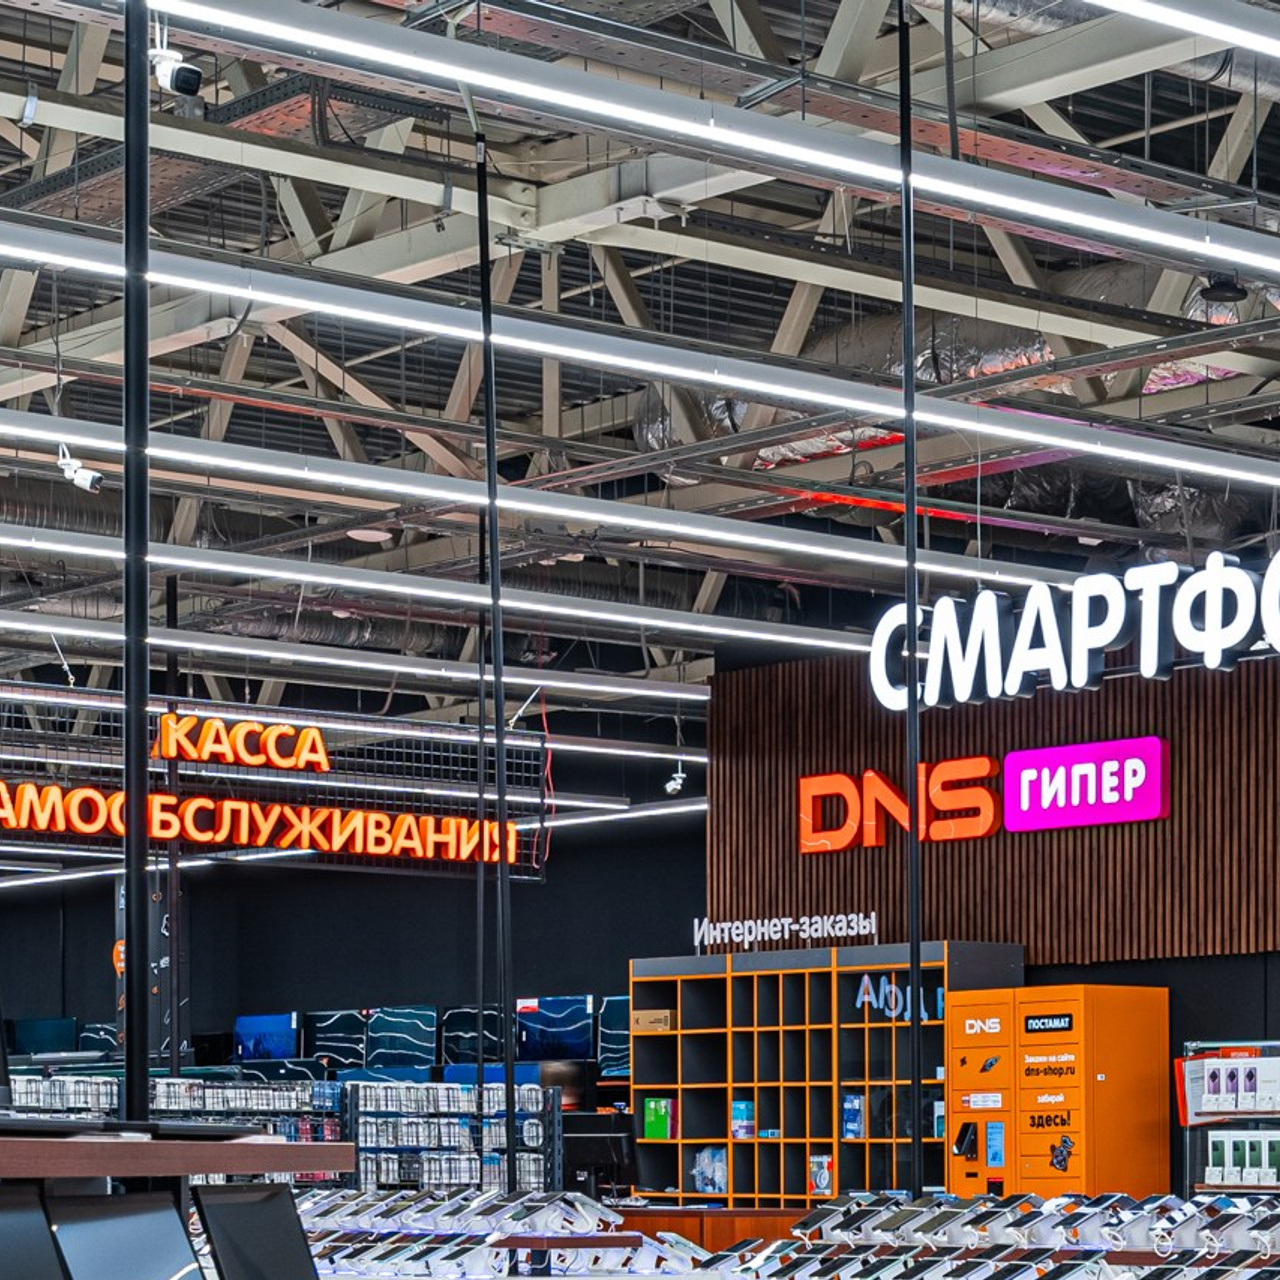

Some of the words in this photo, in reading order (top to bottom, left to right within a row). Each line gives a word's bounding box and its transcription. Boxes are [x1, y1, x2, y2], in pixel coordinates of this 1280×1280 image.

[160, 712, 331, 772] КАССА
[1019, 757, 1146, 812] ГИПЕР
[799, 756, 1000, 853] DNS
[693, 911, 877, 950] Интернет-заказы
[965, 1018, 1001, 1034] DNS
[1027, 1017, 1070, 1030] ПОСТАМАТ
[1024, 1065, 1075, 1078] dns-shop.ru
[1029, 1110, 1071, 1129] здесь!
